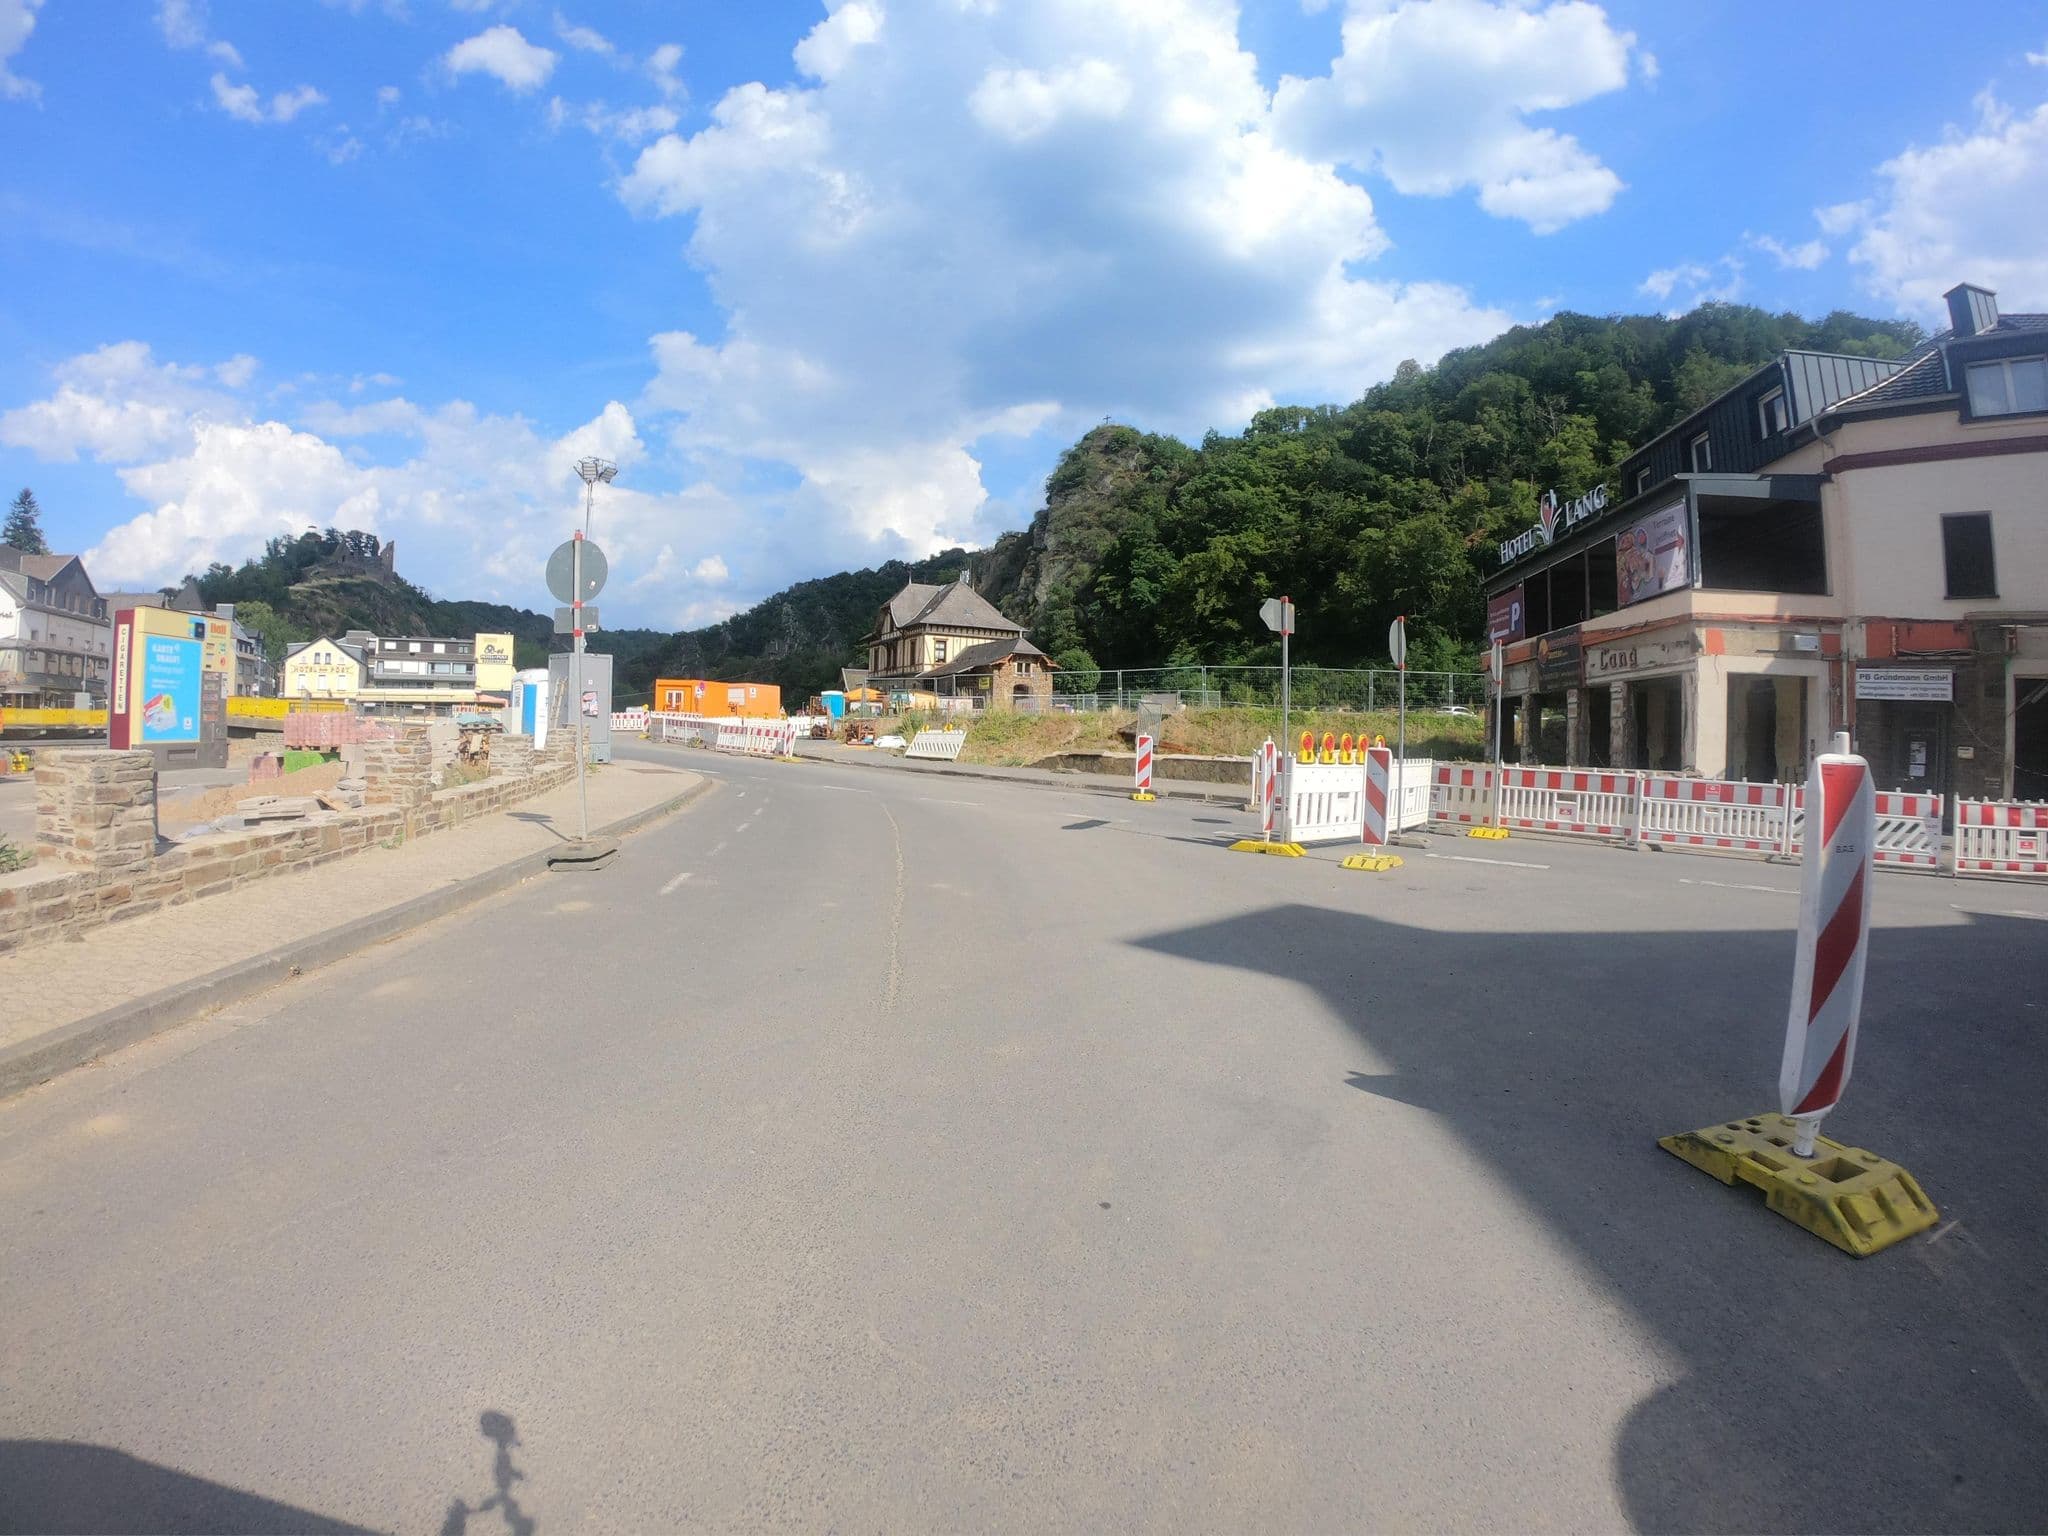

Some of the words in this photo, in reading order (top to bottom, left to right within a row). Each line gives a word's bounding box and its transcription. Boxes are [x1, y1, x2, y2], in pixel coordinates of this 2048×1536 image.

[1500, 529, 1536, 564] HOTEL
[1565, 484, 1608, 527] LANG
[1511, 602, 1521, 631] P
[117, 627, 127, 709] CIGARETTEN
